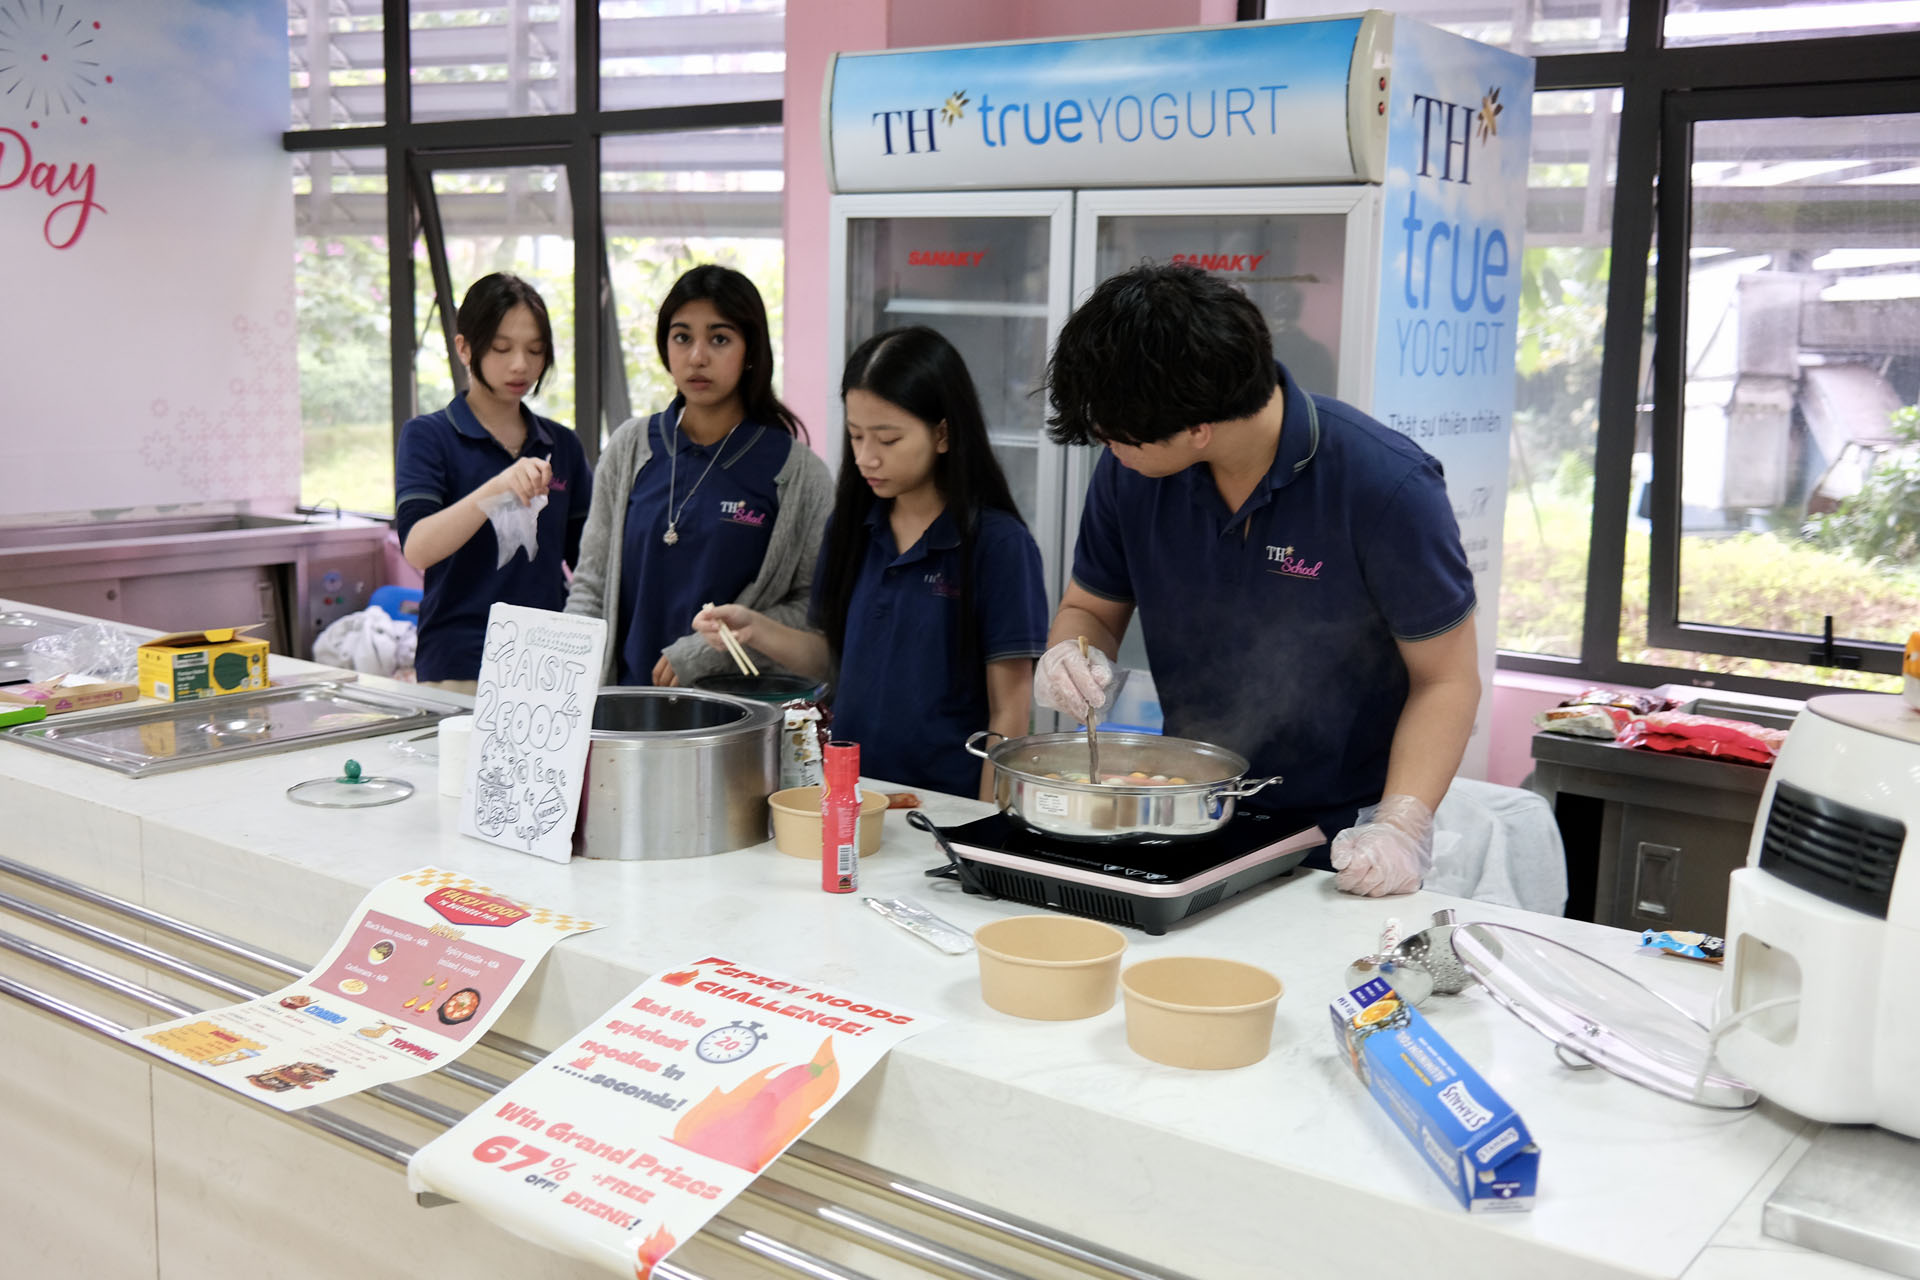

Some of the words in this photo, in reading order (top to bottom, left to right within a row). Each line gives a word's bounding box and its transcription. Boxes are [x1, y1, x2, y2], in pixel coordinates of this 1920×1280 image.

[872, 107, 941, 156] TH
[1412, 94, 1476, 185] TH
[0, 127, 108, 250] Day
[908, 250, 985, 267] SANAKY
[1402, 191, 1509, 314] true
[1396, 319, 1504, 377] YOGURT
[720, 501, 738, 513] TH
[1266, 545, 1286, 562] TH
[1281, 556, 1323, 577] School
[482, 901, 523, 918] FOOD
[694, 981, 875, 1037] CHALLENGE!
[714, 966, 811, 994] SPICY
[804, 992, 915, 1025] NOODS
[606, 1019, 689, 1052] spiciest
[669, 1009, 707, 1028] the
[389, 1038, 440, 1061] TOPPING
[579, 1040, 663, 1073] noodles
[661, 1064, 686, 1081] in
[713, 1036, 741, 1051] 20
[1443, 1085, 1487, 1128] STAHAUS
[495, 1101, 547, 1131] Win
[545, 1122, 637, 1165] Grand
[627, 1153, 723, 1200] Prizes
[523, 1173, 561, 1193] OFF!
[561, 1190, 643, 1231] DRINK!
